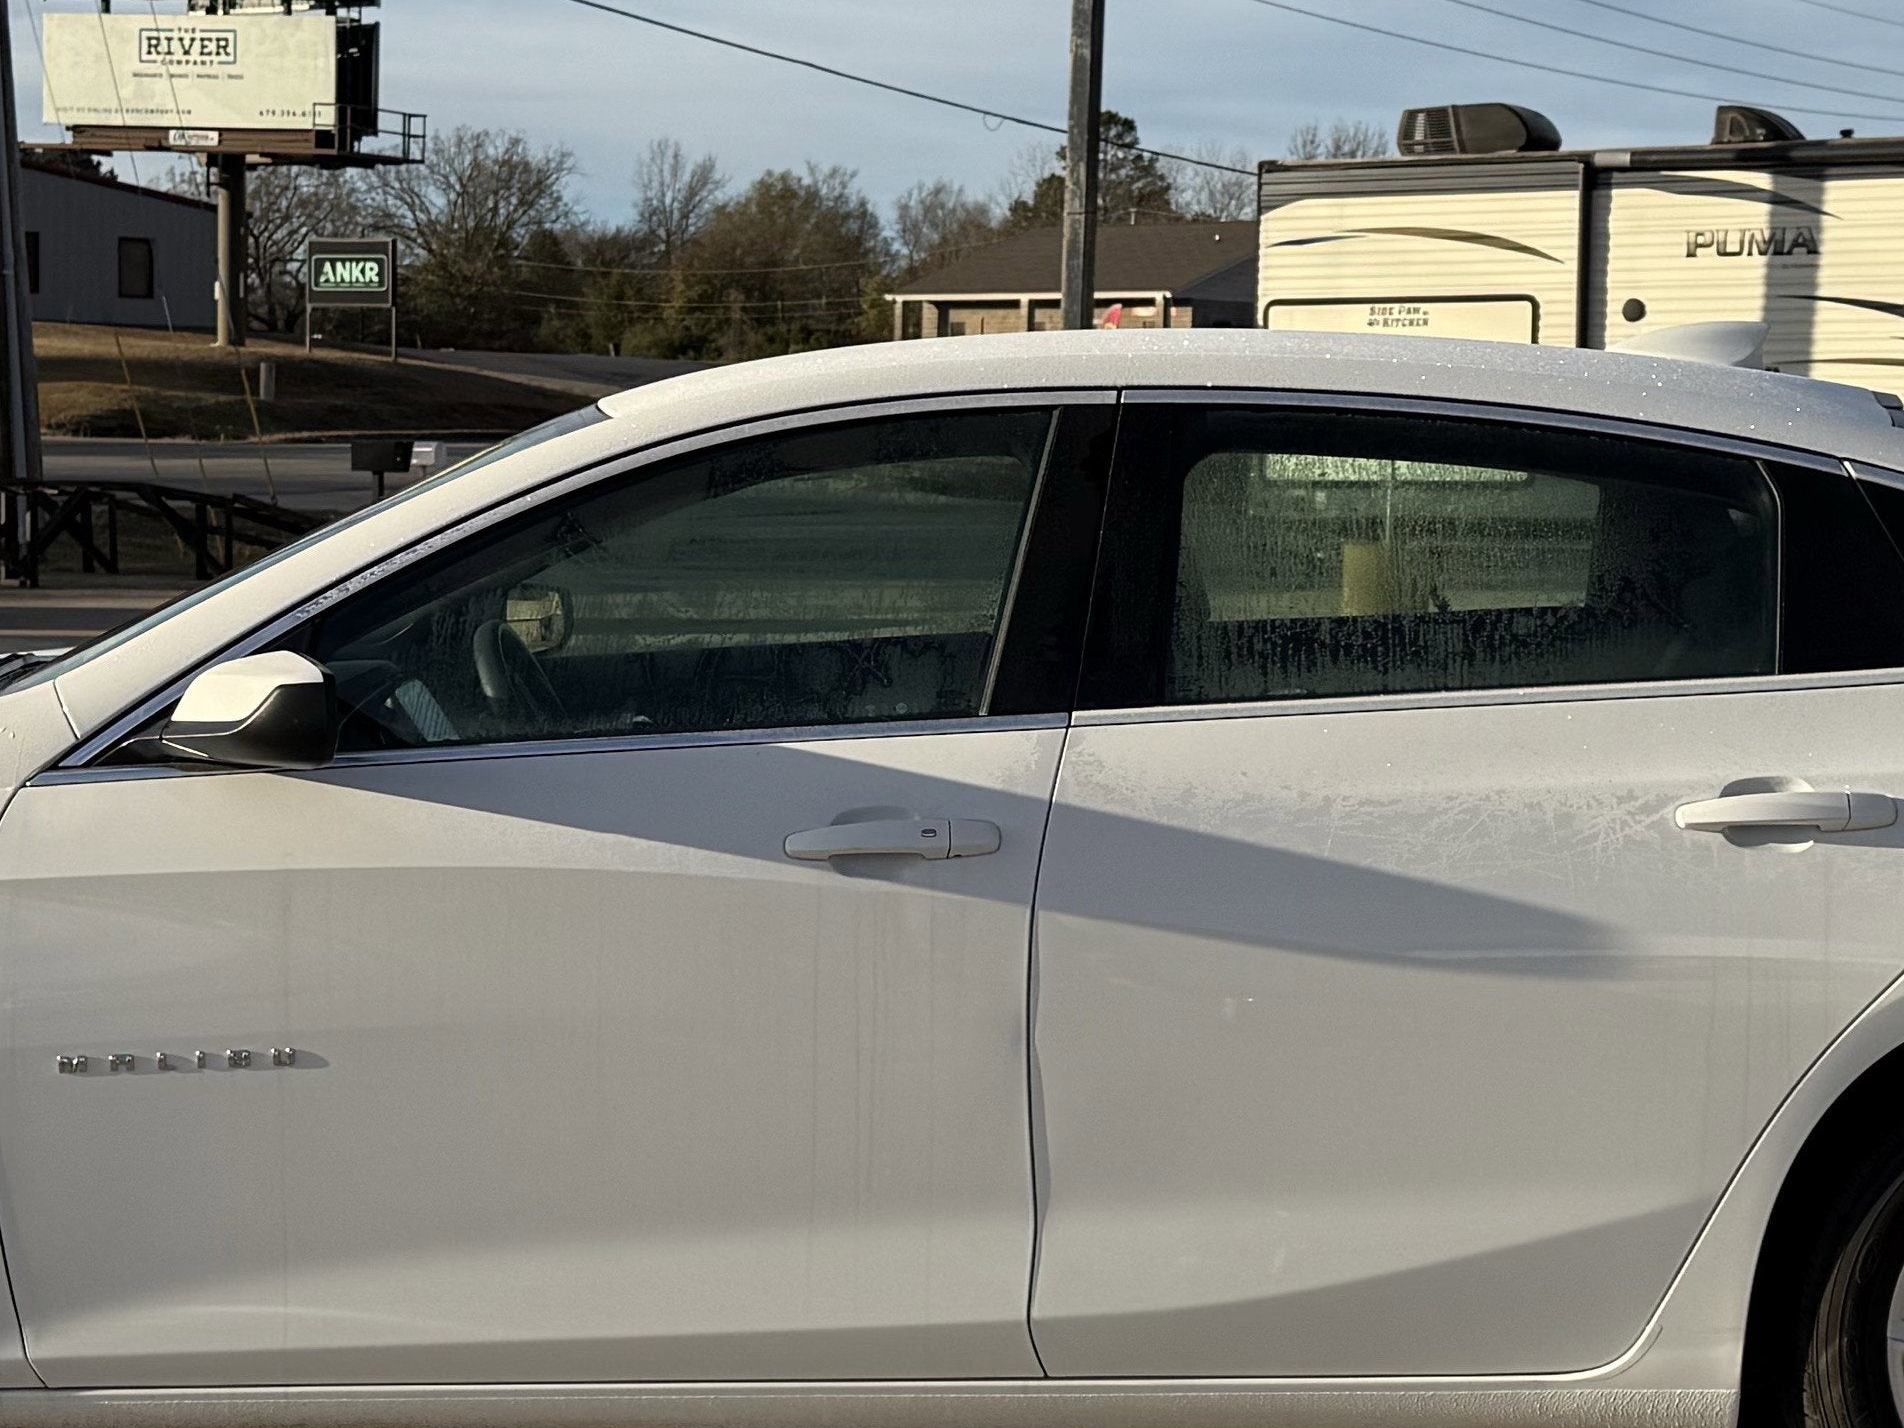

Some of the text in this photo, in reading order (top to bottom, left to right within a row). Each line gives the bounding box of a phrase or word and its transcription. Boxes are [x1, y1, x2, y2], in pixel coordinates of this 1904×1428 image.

[145, 36, 232, 57] RIVER
[1685, 225, 1822, 258] PUMA
[319, 261, 380, 283] ANKR
[57, 1047, 297, 1074] MALIBU
